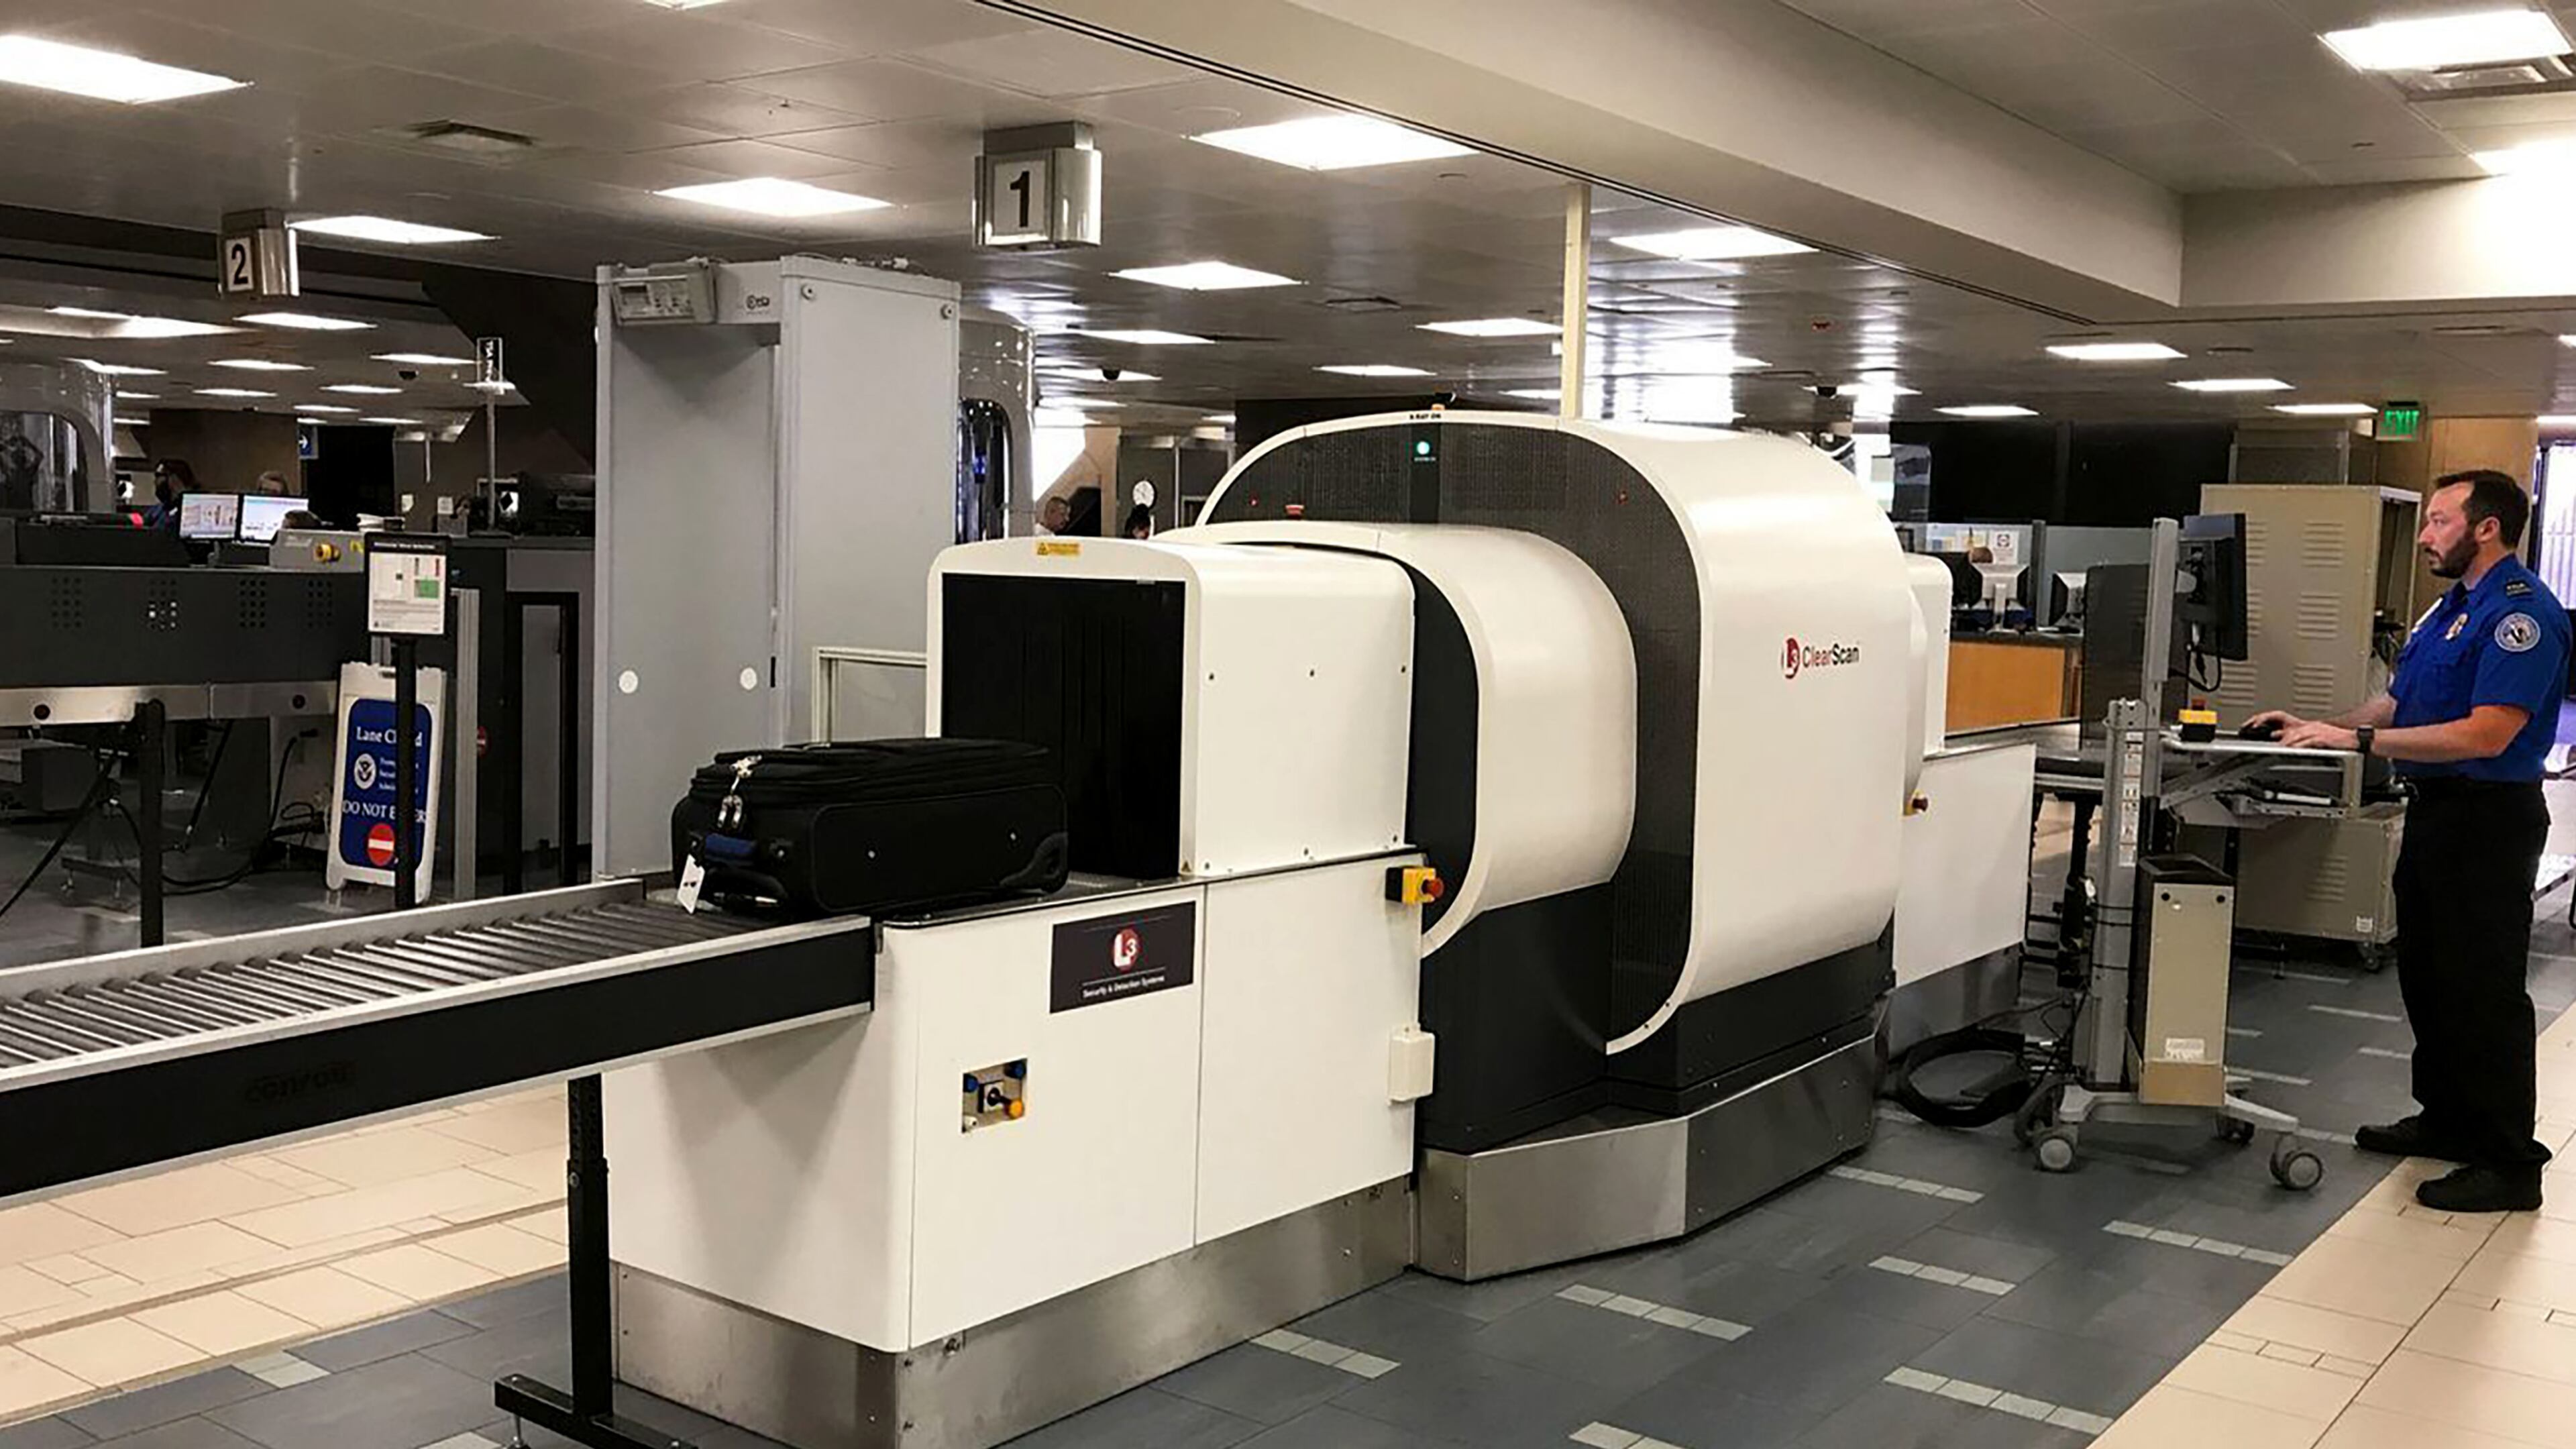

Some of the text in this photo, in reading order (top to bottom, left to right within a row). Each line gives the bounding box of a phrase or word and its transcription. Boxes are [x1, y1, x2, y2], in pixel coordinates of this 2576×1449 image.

[1010, 170, 1030, 227] 1
[231, 244, 247, 284] 2
[2383, 409, 2420, 435] EXIT
[1803, 643, 1859, 668] ClearScan
[356, 727, 382, 743] Lane
[362, 802, 387, 818] NOT
[1083, 986, 1107, 998] Security
